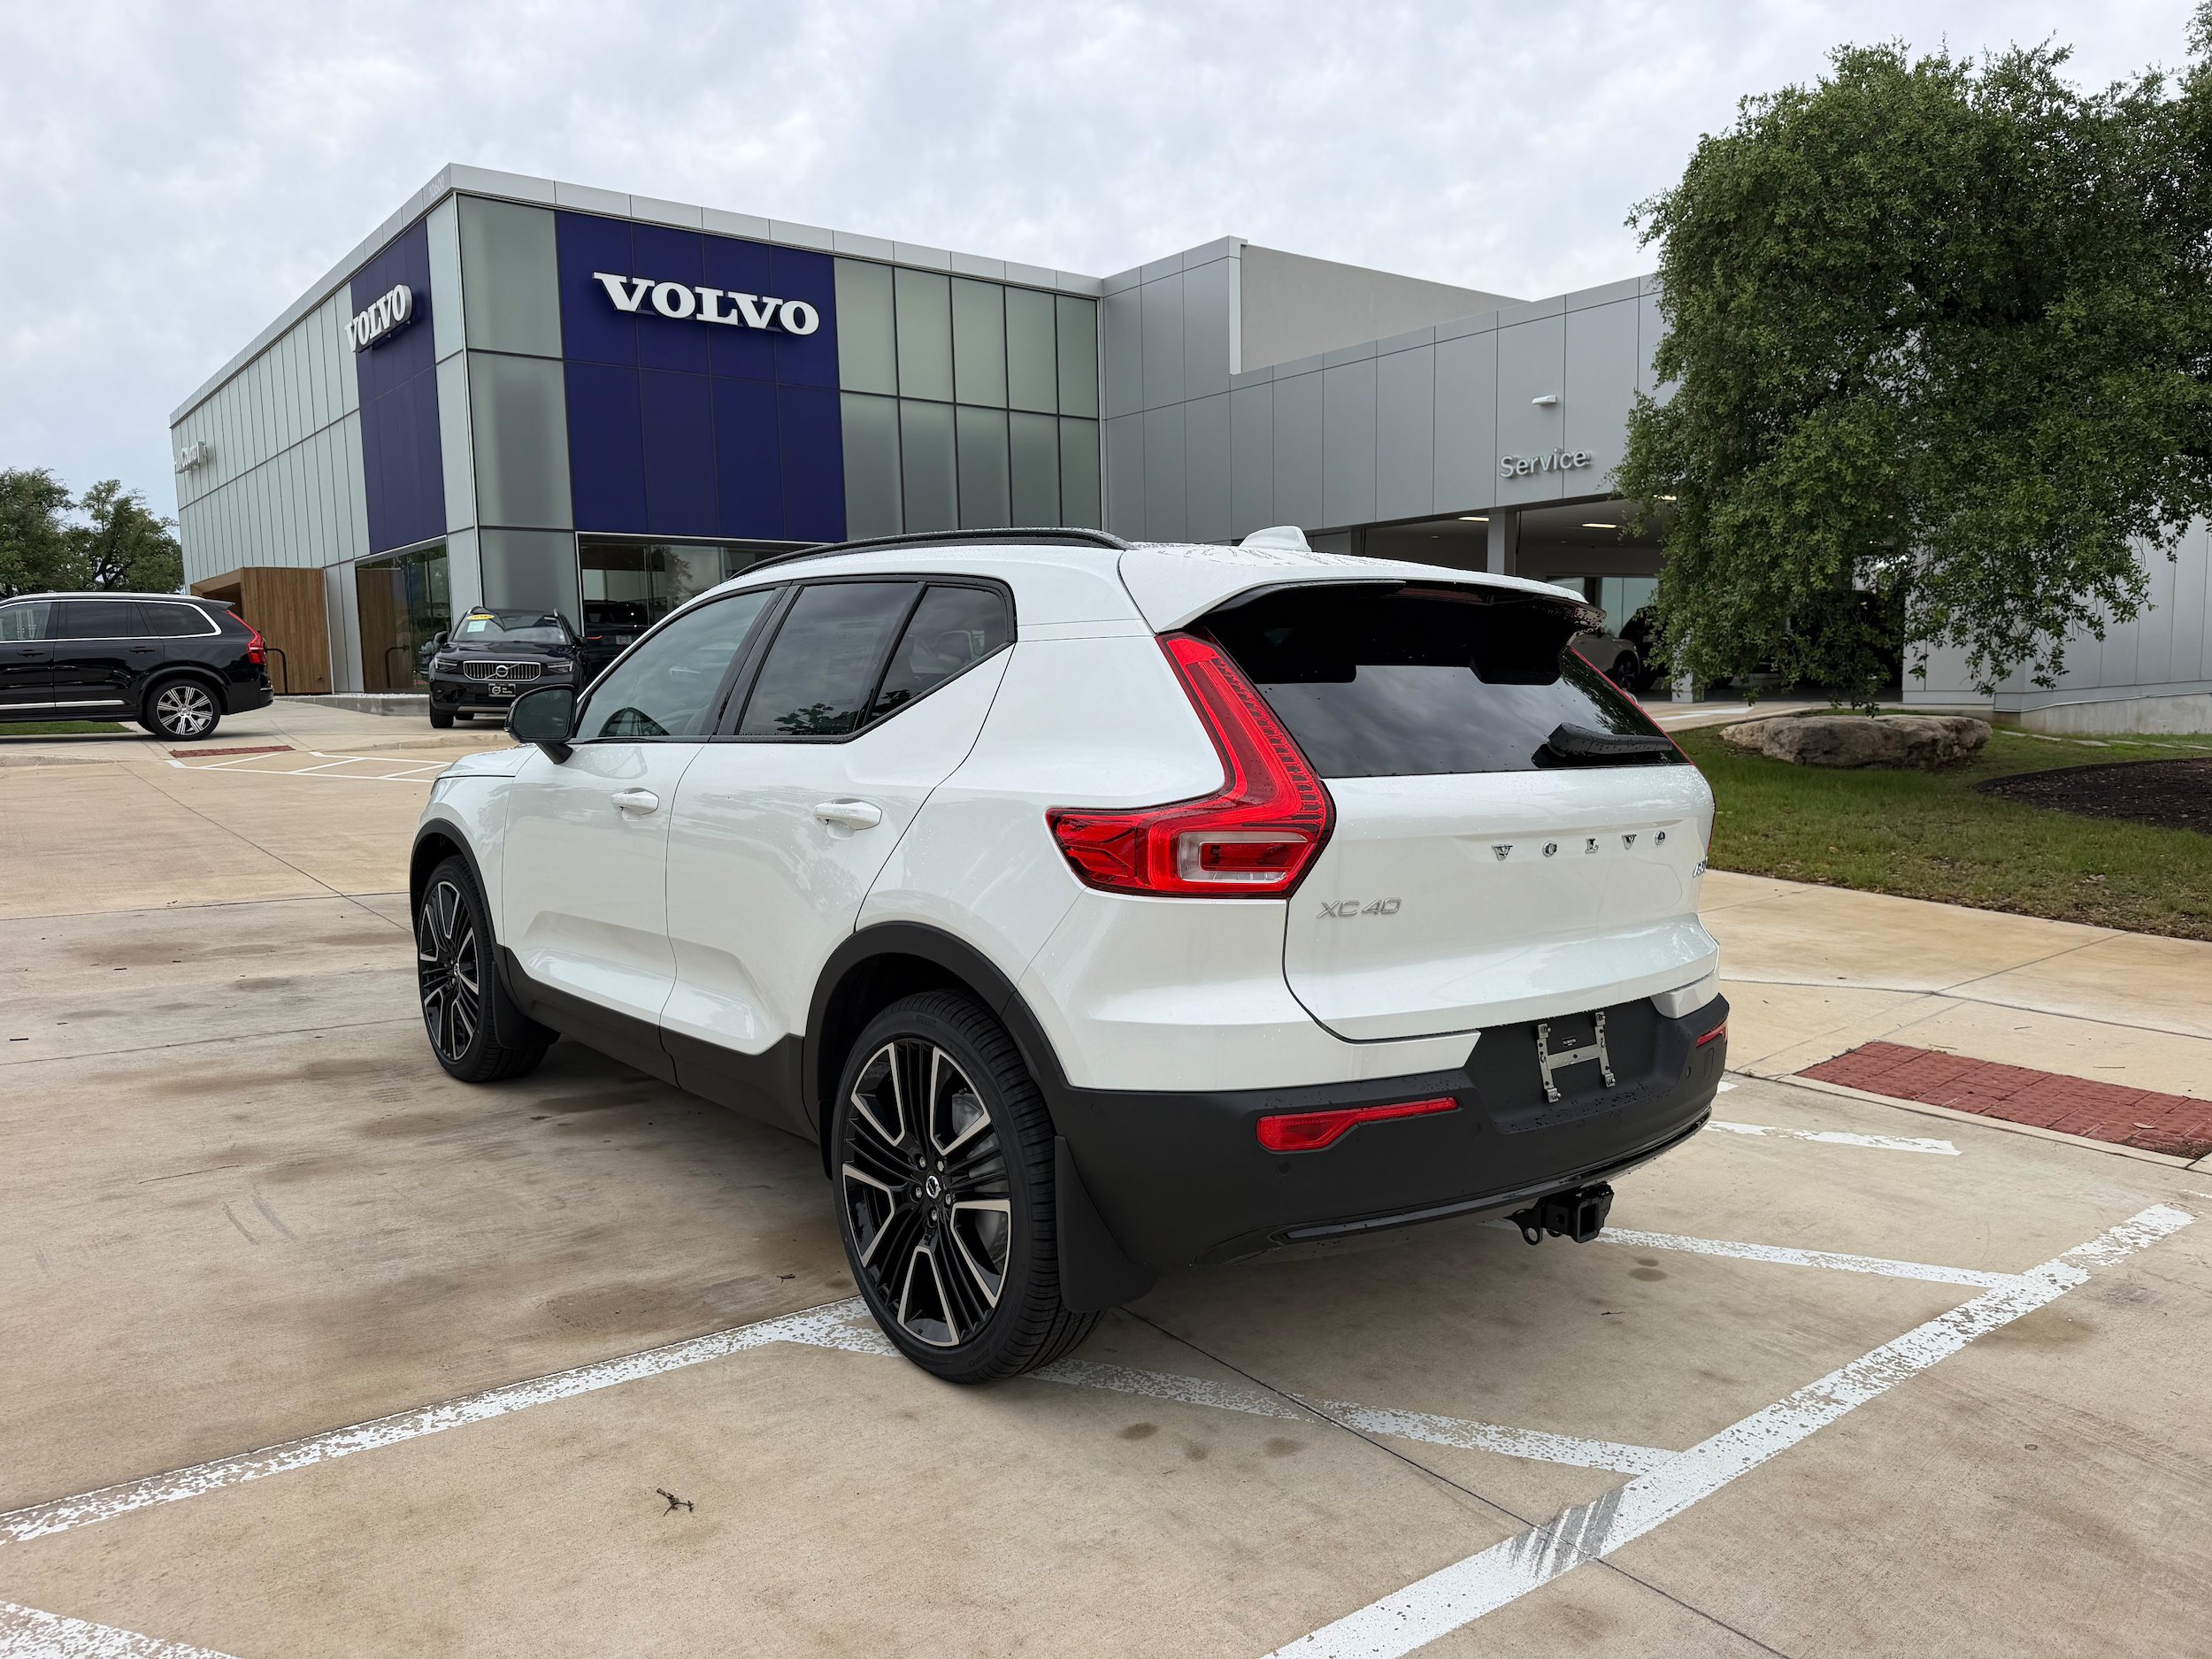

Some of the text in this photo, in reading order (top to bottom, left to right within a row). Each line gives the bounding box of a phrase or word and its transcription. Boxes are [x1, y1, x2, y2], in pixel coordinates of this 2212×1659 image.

[344, 284, 412, 352] VOLVO
[592, 272, 820, 335] VOLVO
[1500, 447, 1591, 479] Service
[1492, 830, 1666, 861] VOLVO
